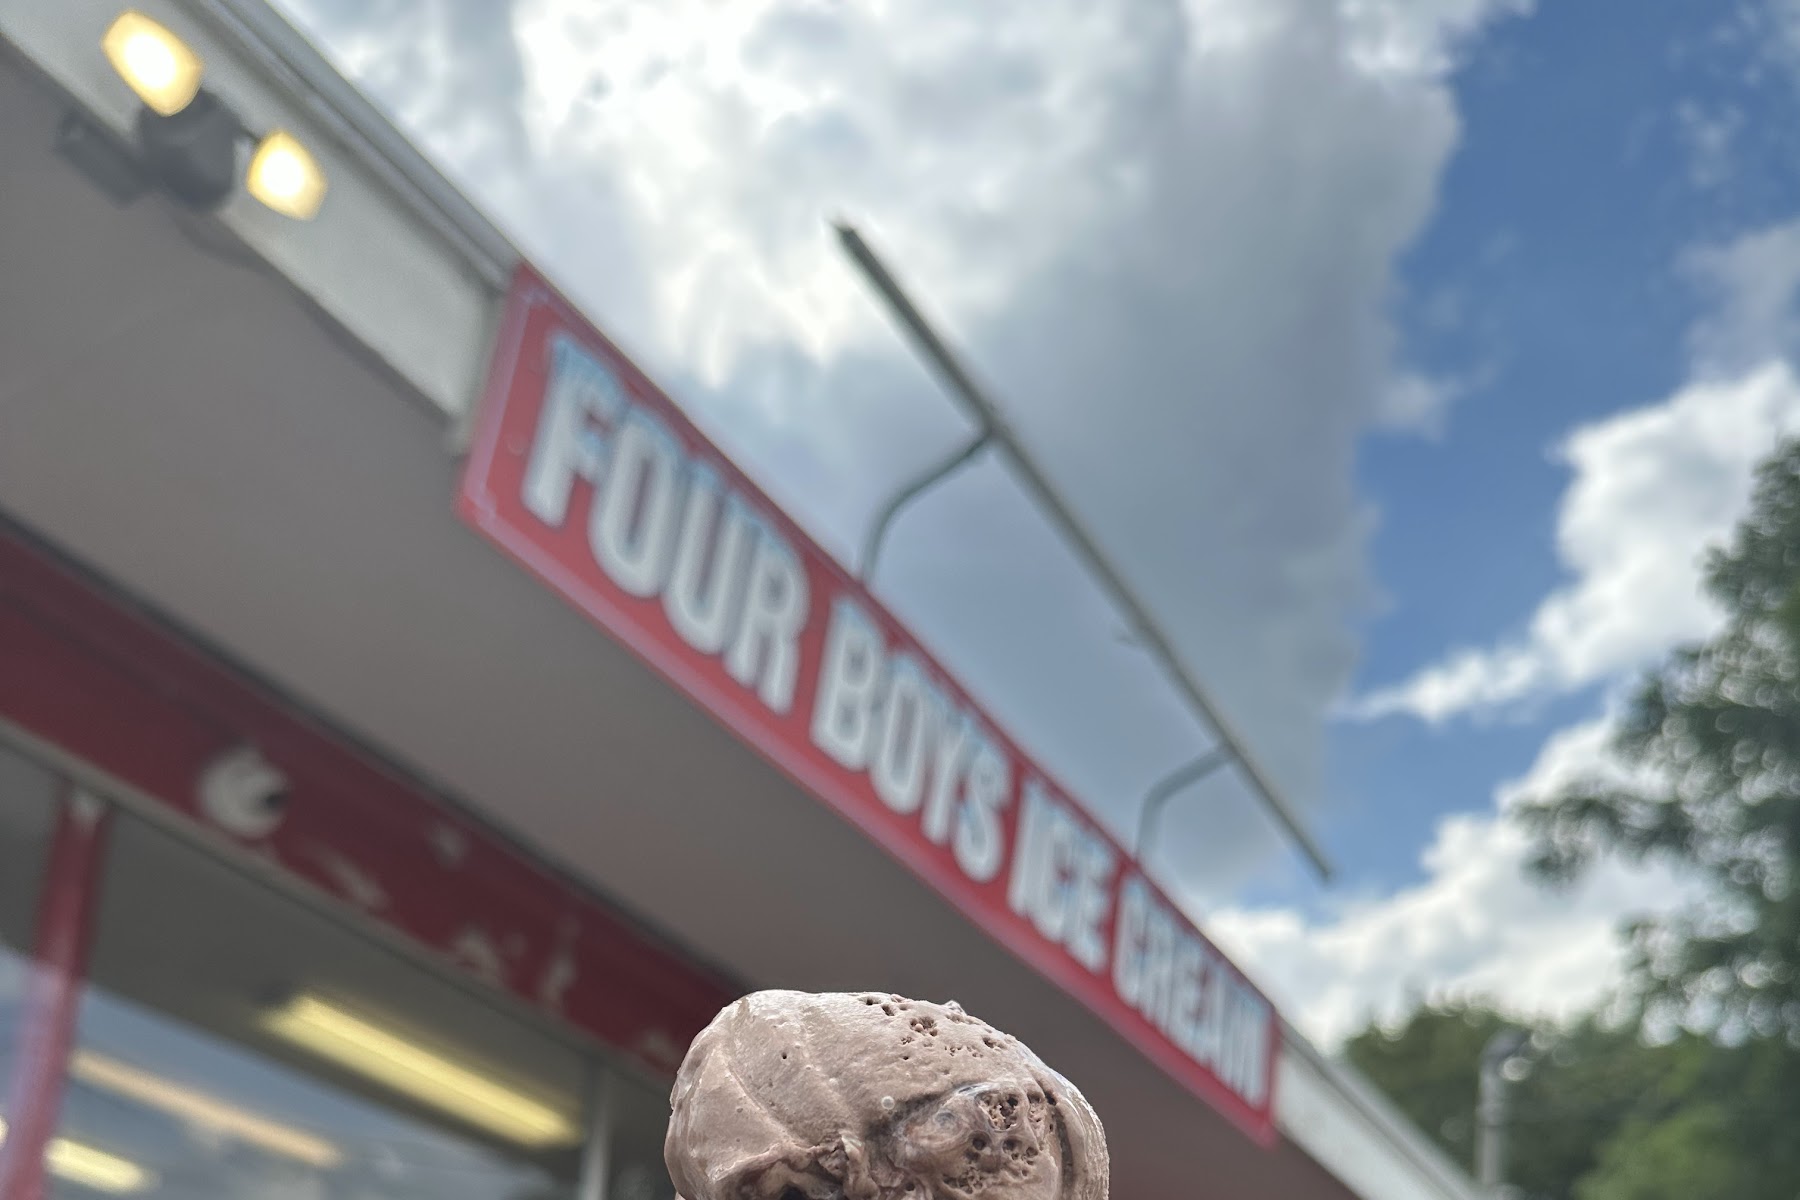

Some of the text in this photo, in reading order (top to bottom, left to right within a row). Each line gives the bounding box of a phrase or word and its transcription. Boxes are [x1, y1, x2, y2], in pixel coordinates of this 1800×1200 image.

[523, 332, 1267, 1108] FOUR BOYS ICE CREAM
